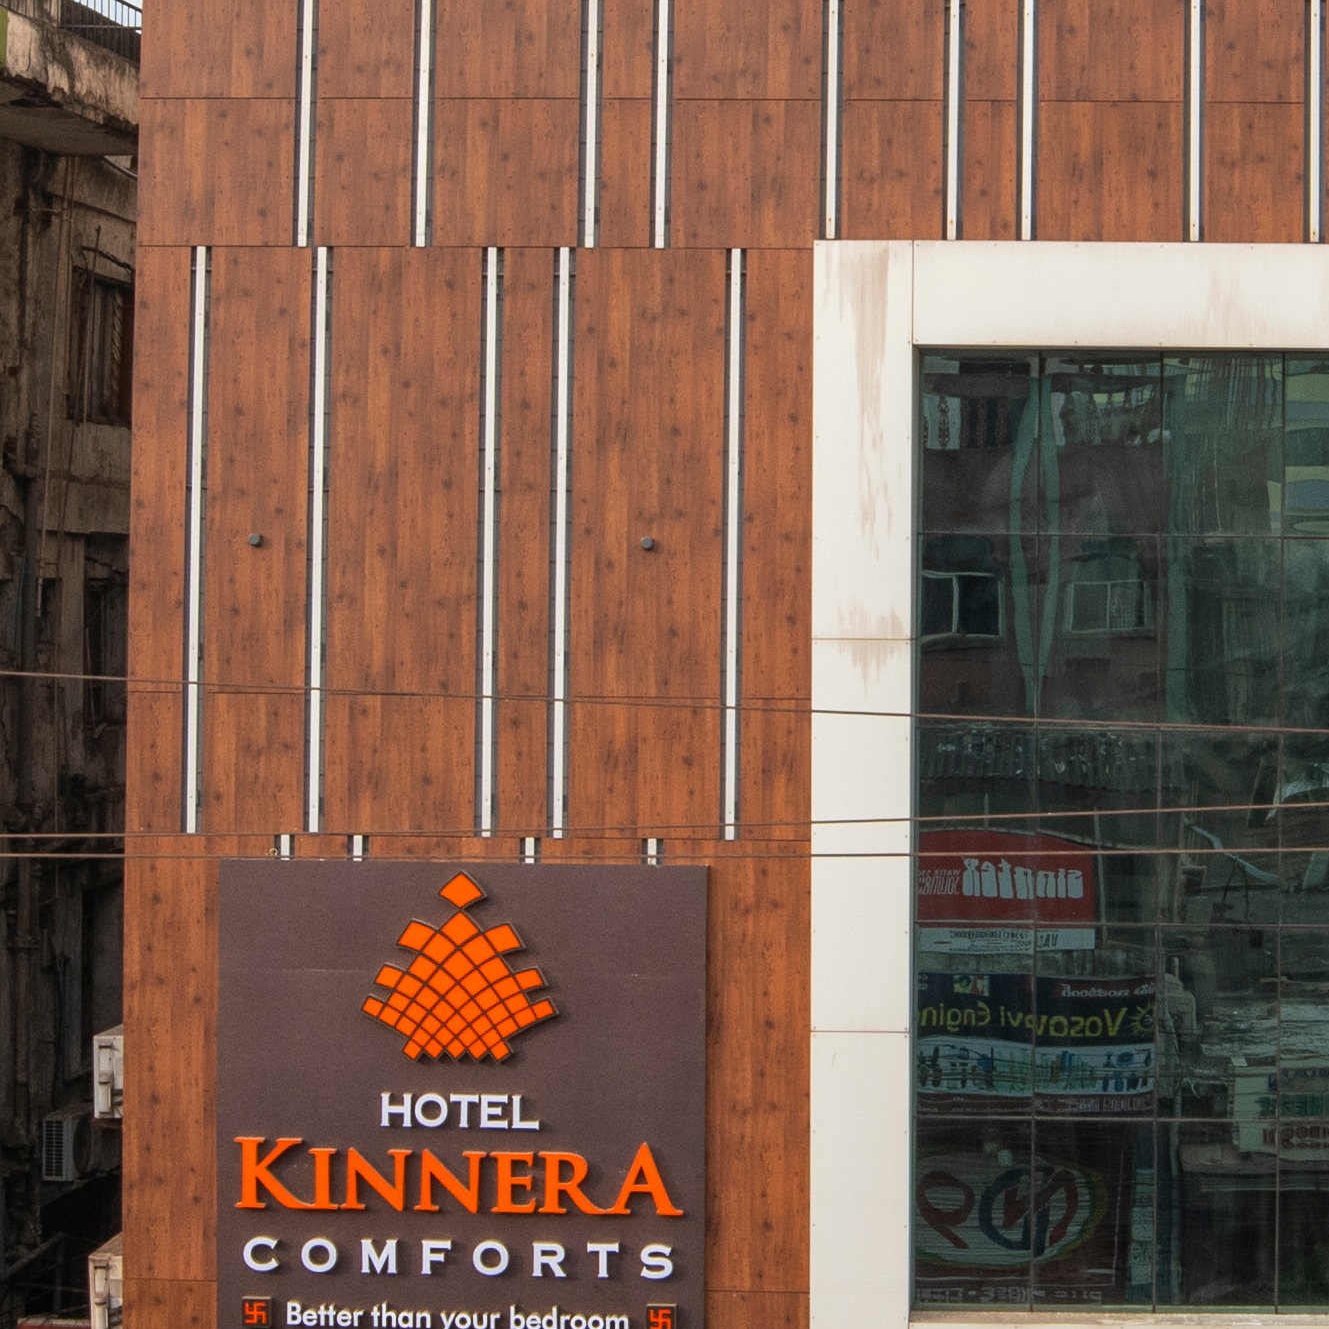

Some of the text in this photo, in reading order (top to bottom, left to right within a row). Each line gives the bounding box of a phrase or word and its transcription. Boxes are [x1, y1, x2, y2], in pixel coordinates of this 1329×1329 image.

[380, 1091, 539, 1131] HOTEL
[234, 1136, 684, 1216] KINNERA
[242, 1236, 674, 1280] COMFORTS
[286, 1301, 364, 1329] Better
[371, 1304, 431, 1329] than
